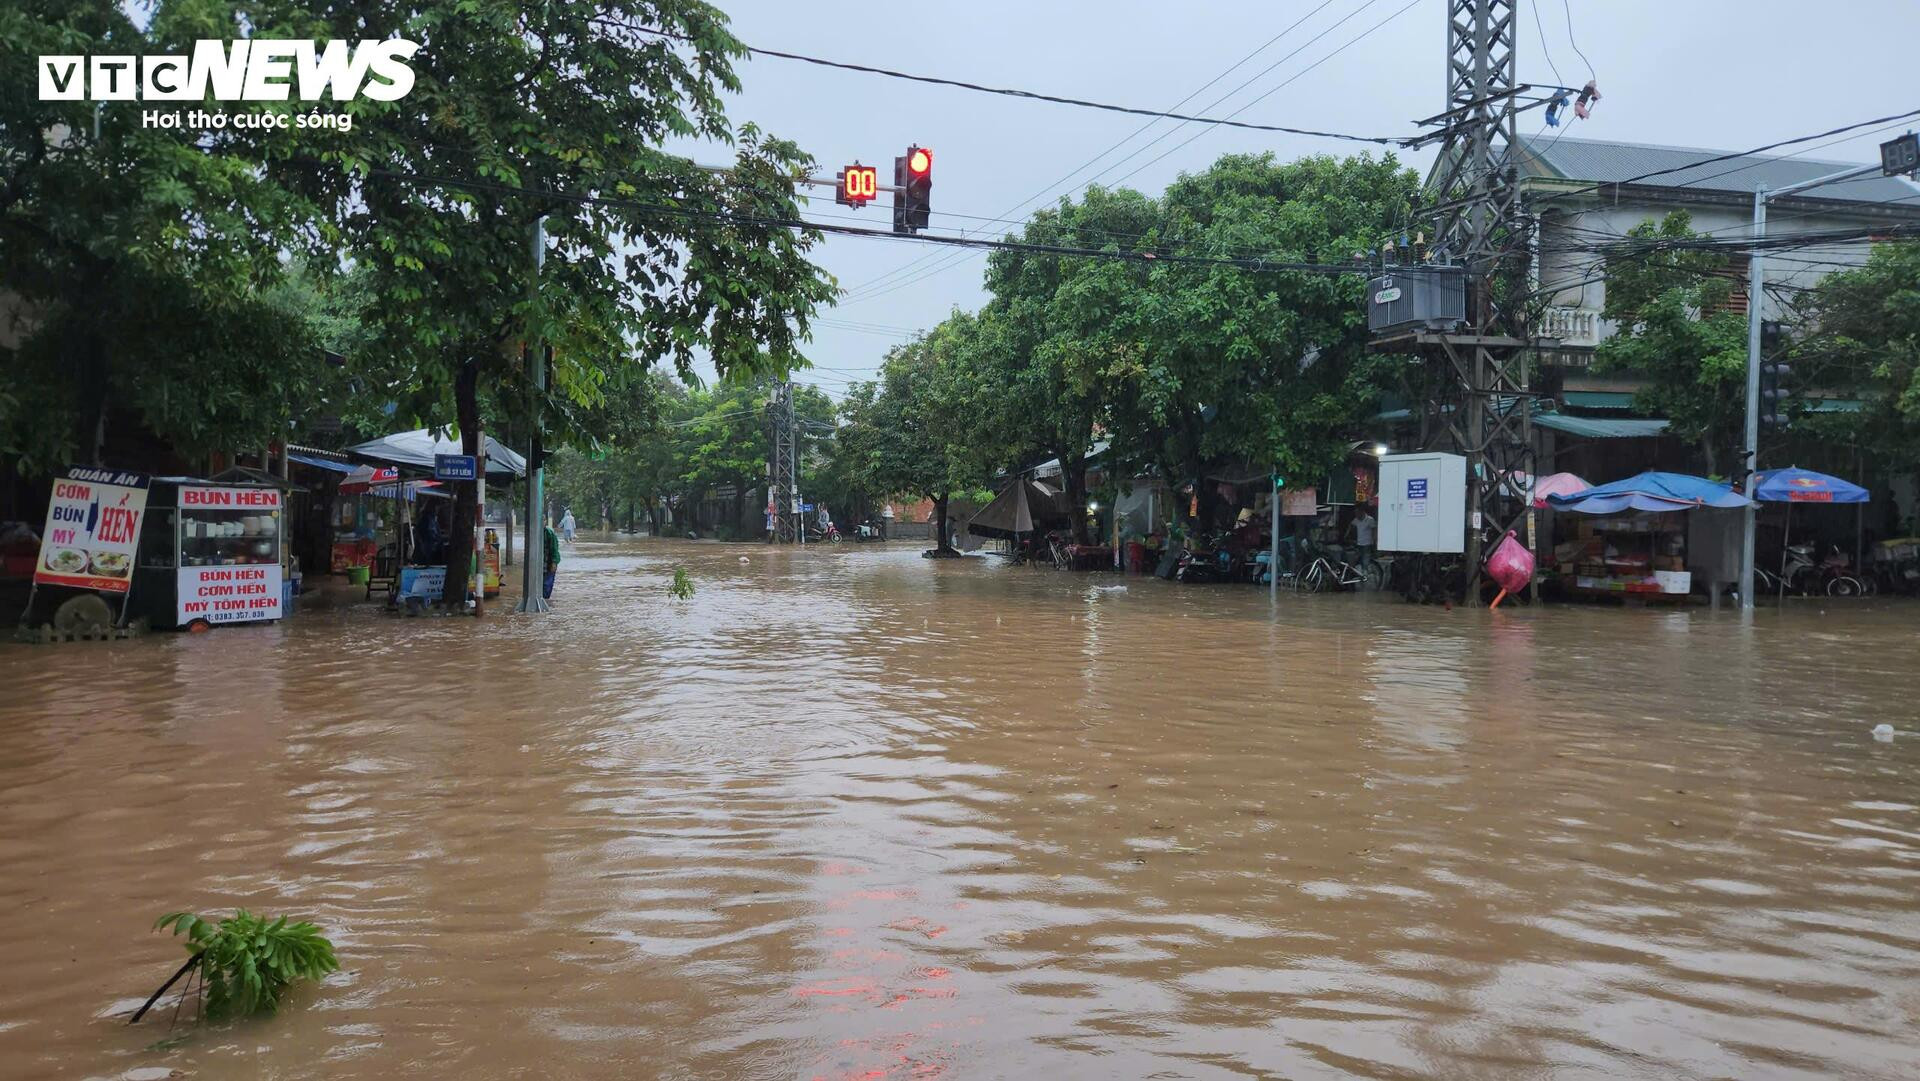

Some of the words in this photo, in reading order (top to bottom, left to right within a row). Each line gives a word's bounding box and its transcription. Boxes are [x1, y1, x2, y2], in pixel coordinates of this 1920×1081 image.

[847, 169, 875, 196] 00
[68, 467, 114, 483] QUÁN
[114, 472, 140, 486] ĂN
[55, 483, 91, 501] CƠM
[184, 488, 231, 505] BÚN
[236, 489, 277, 506] HẾN
[52, 504, 85, 523] BÚN
[98, 493, 139, 544] HẾN
[200, 569, 232, 581] BÚN
[235, 568, 265, 580] HẾN
[198, 585, 233, 597] CƠM
[237, 582, 266, 594] HẾN
[213, 598, 246, 611] TÔM
[249, 596, 278, 608] HẾN
